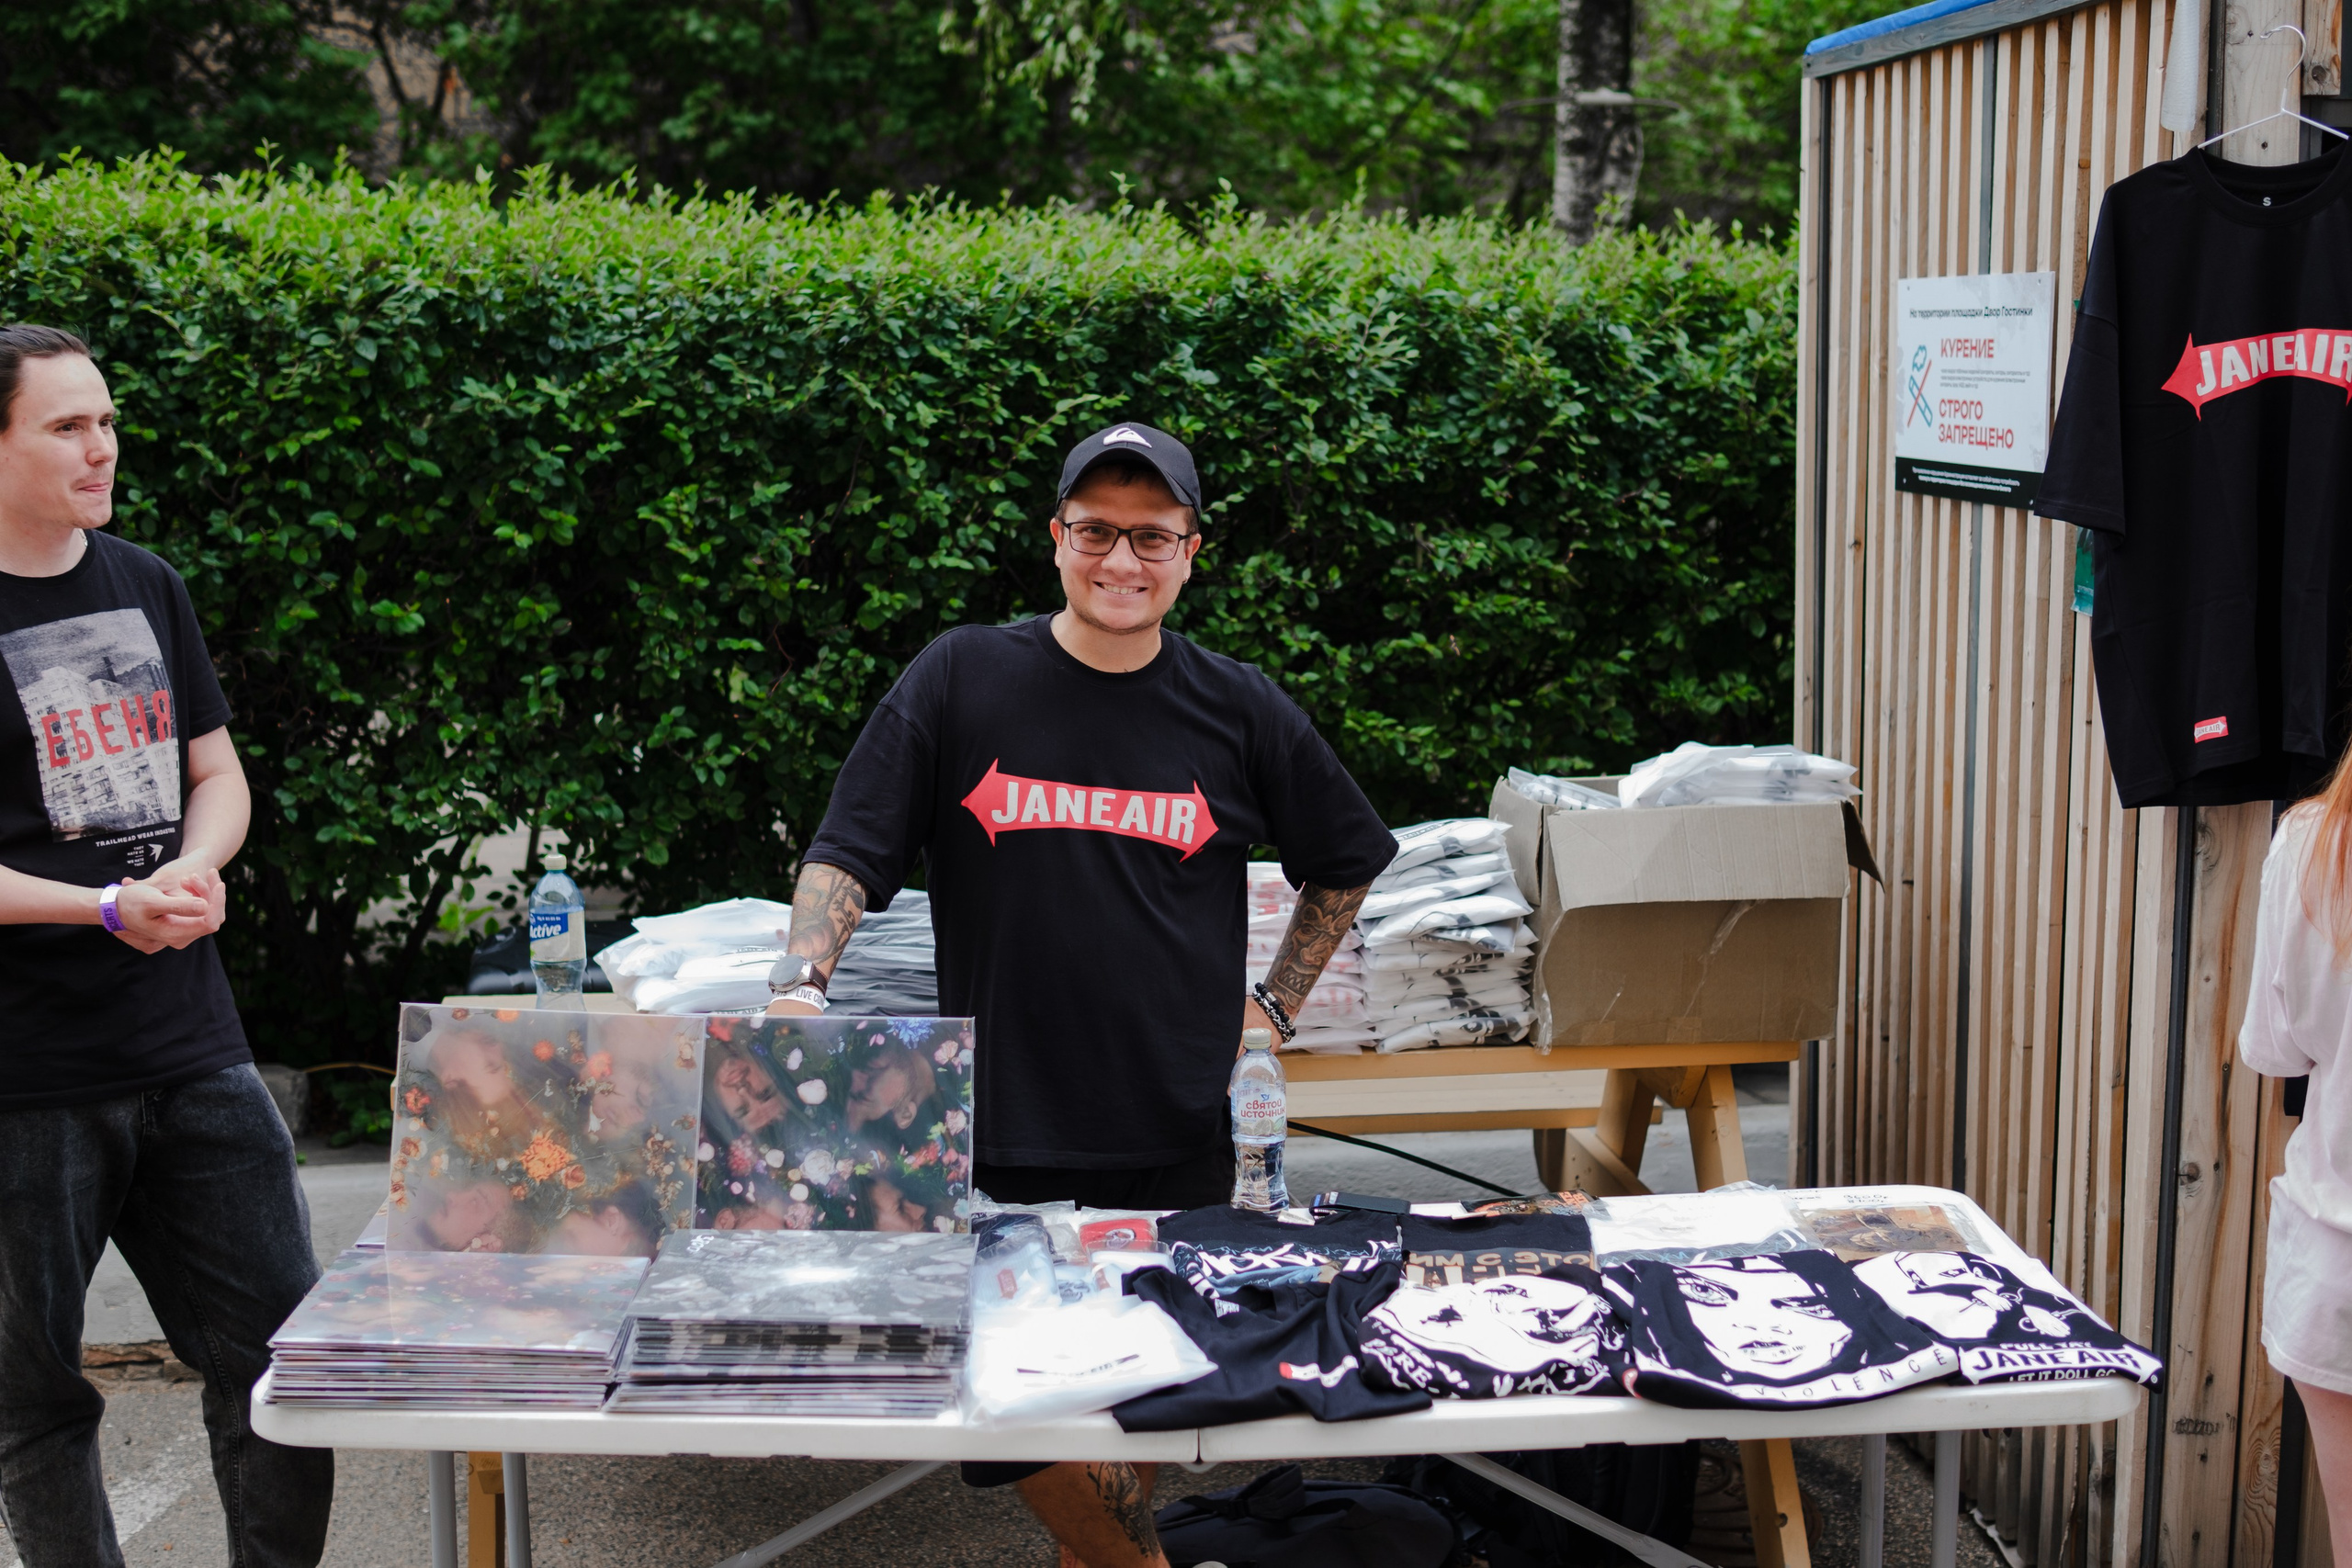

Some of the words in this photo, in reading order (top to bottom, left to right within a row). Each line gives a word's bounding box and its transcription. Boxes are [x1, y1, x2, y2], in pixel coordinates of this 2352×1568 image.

[2263, 197, 2271, 207] S
[1984, 306, 2000, 319] Двор
[1940, 338, 1995, 358] КУРЕНИЕ
[1939, 398, 1984, 420] СТРОГО
[1938, 423, 2015, 450] ЗАПРЕЩЕНО
[95, 835, 136, 847] TRAILHEAD
[796, 988, 813, 1000] LIVE
